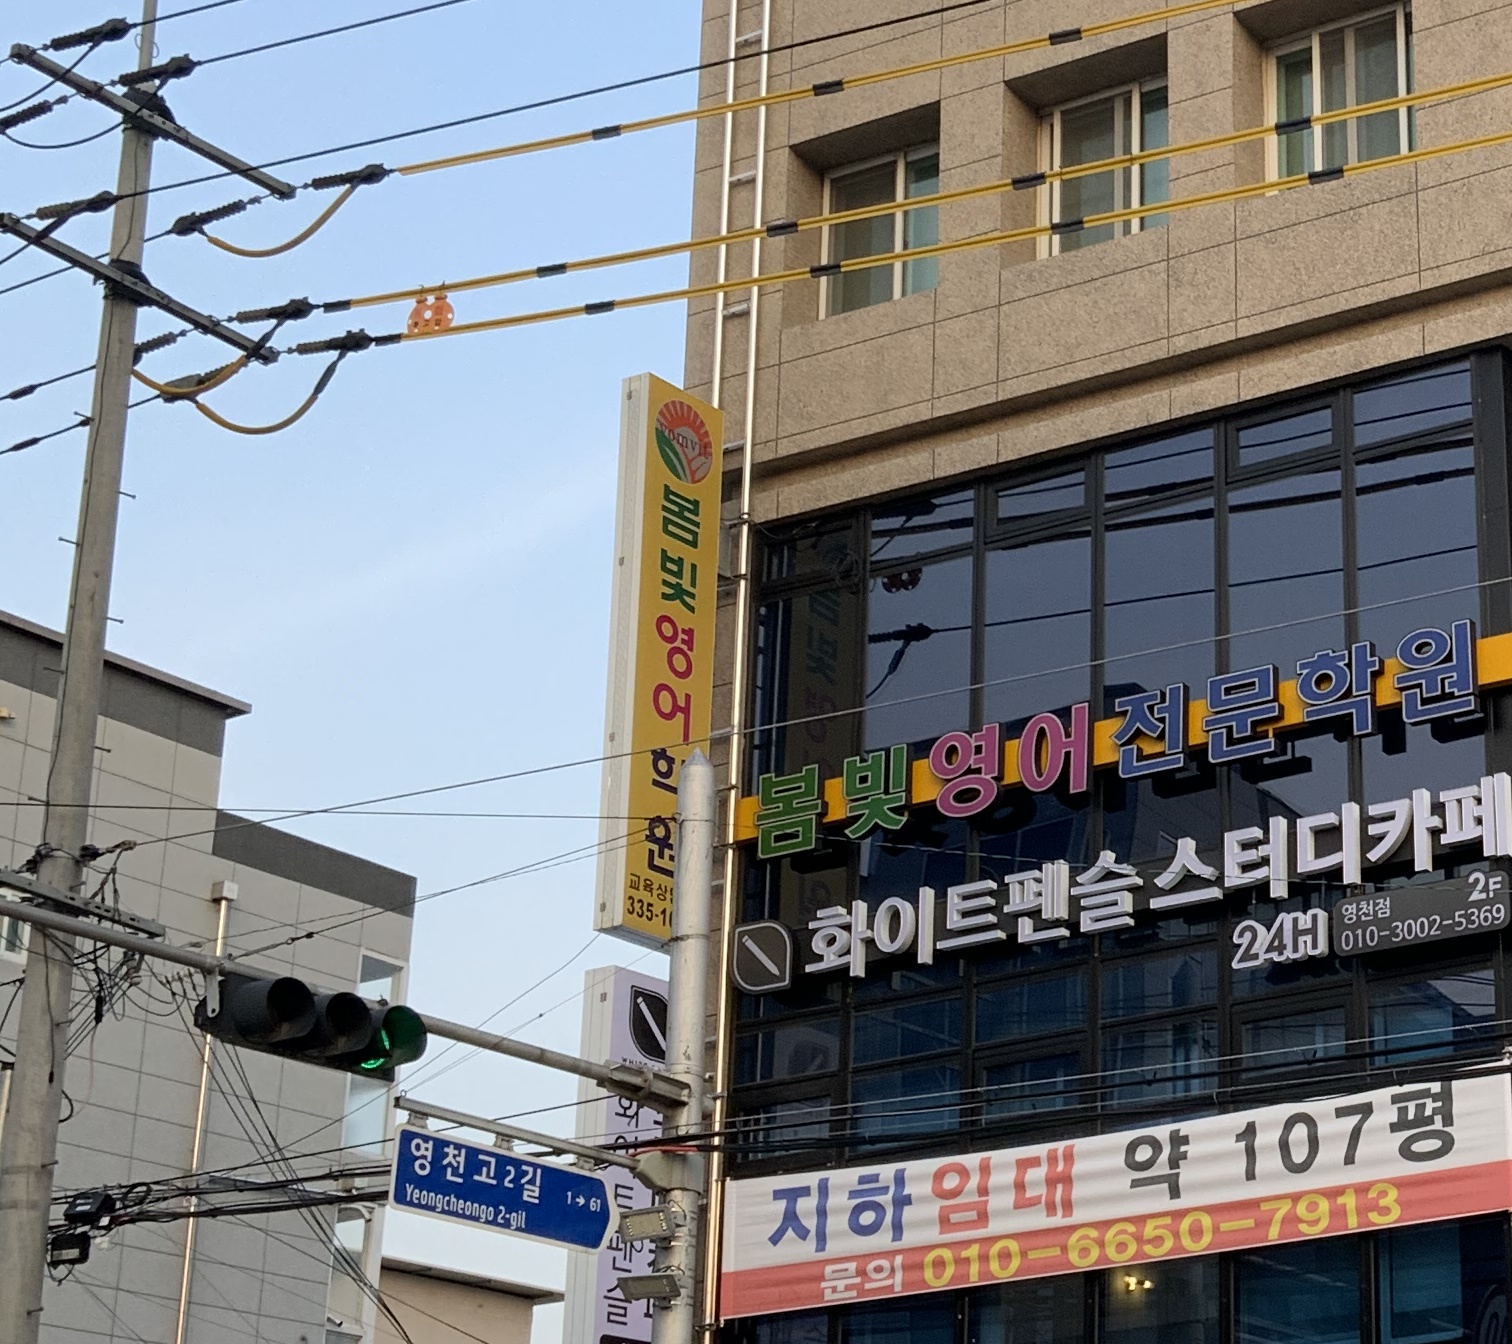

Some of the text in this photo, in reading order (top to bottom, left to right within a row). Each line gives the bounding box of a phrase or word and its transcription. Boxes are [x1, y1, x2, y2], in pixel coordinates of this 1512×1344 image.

[1342, 898, 1392, 921] 영천점
[1467, 872, 1504, 901] 2F
[1231, 908, 1331, 970] 24H
[1340, 903, 1506, 952] 010-3002-5369
[1123, 1127, 1190, 1200] 약
[1234, 1080, 1457, 1183] 107평
[405, 1183, 527, 1230] Yeongcheongo 2-gil
[819, 1182, 1402, 1302] 문의 010-6650-7913
